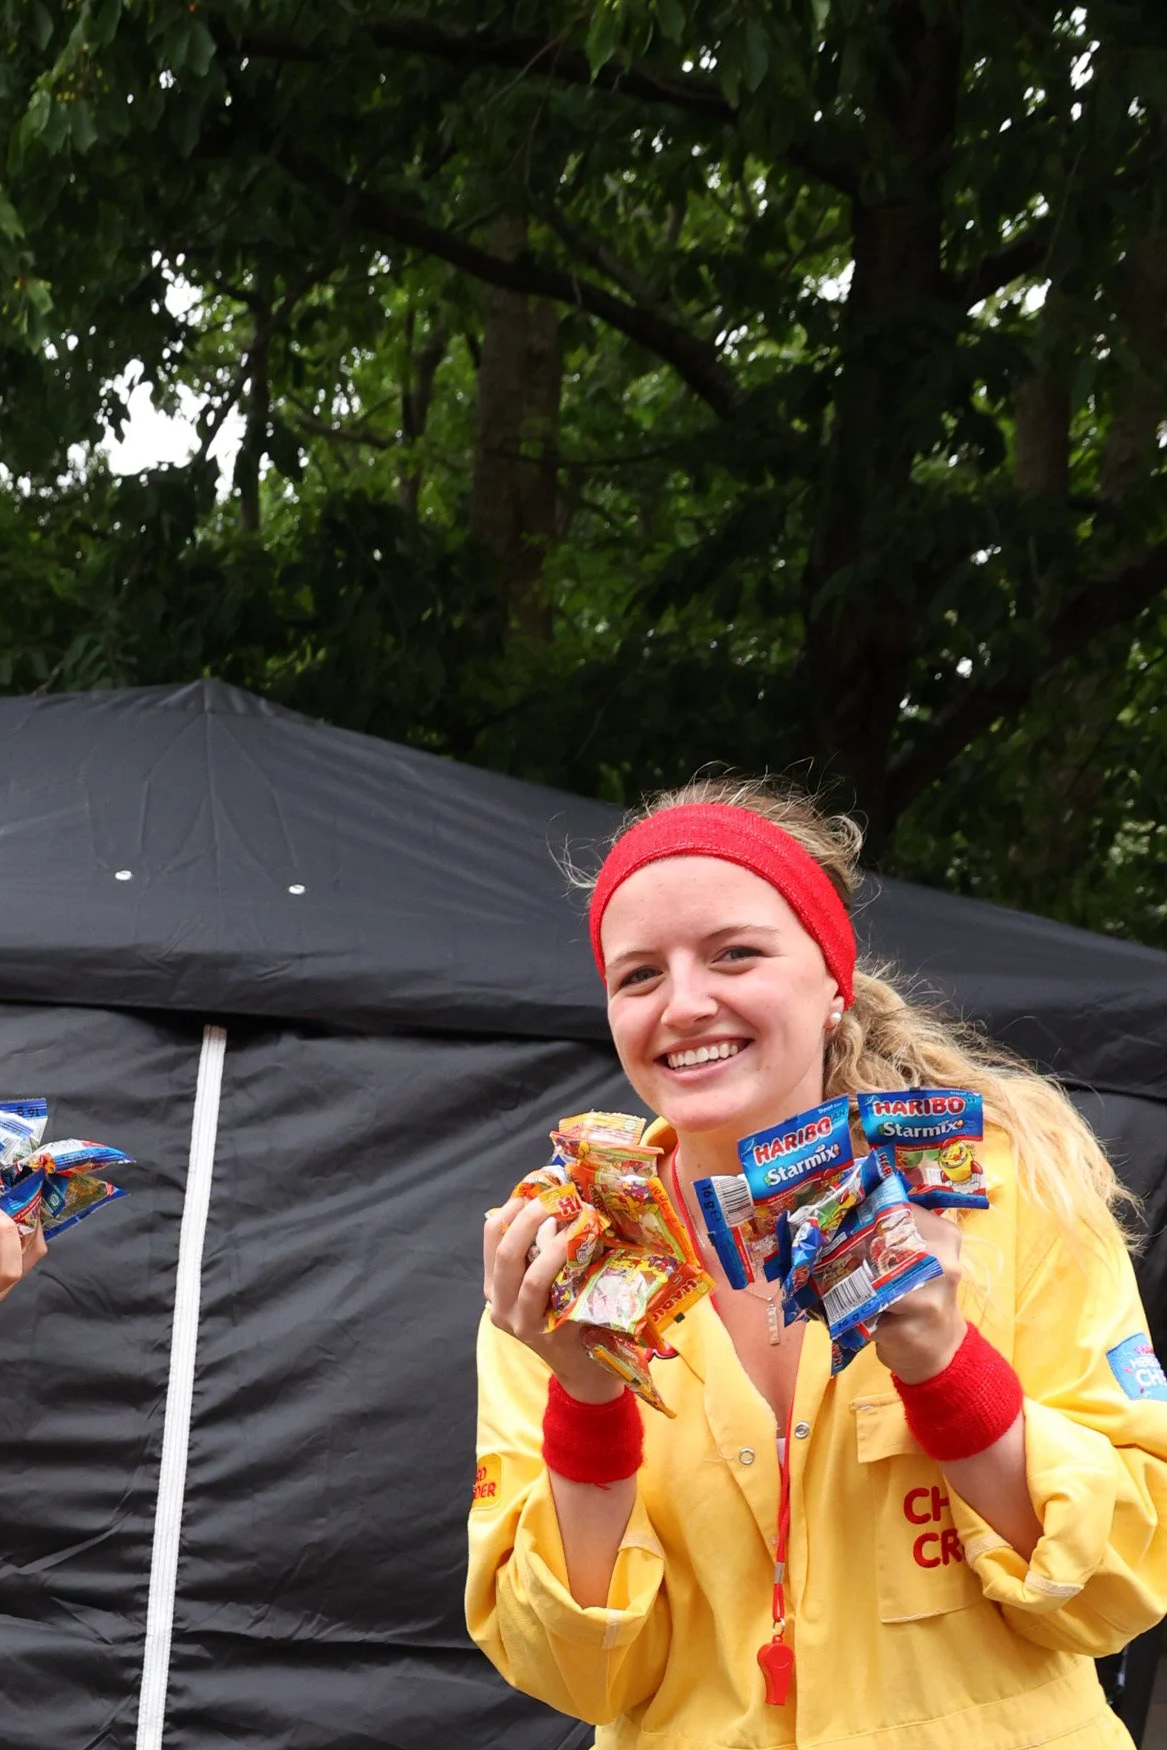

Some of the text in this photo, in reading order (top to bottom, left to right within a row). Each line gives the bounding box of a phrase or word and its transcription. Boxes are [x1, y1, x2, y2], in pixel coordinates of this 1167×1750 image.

[873, 1096, 966, 1116] HARIBO
[753, 1116, 833, 1167] HARIBO
[883, 1119, 958, 1138] Starmix
[767, 1144, 838, 1186] Starmix
[903, 1486, 949, 1525] CH
[913, 1528, 964, 1569] CR
